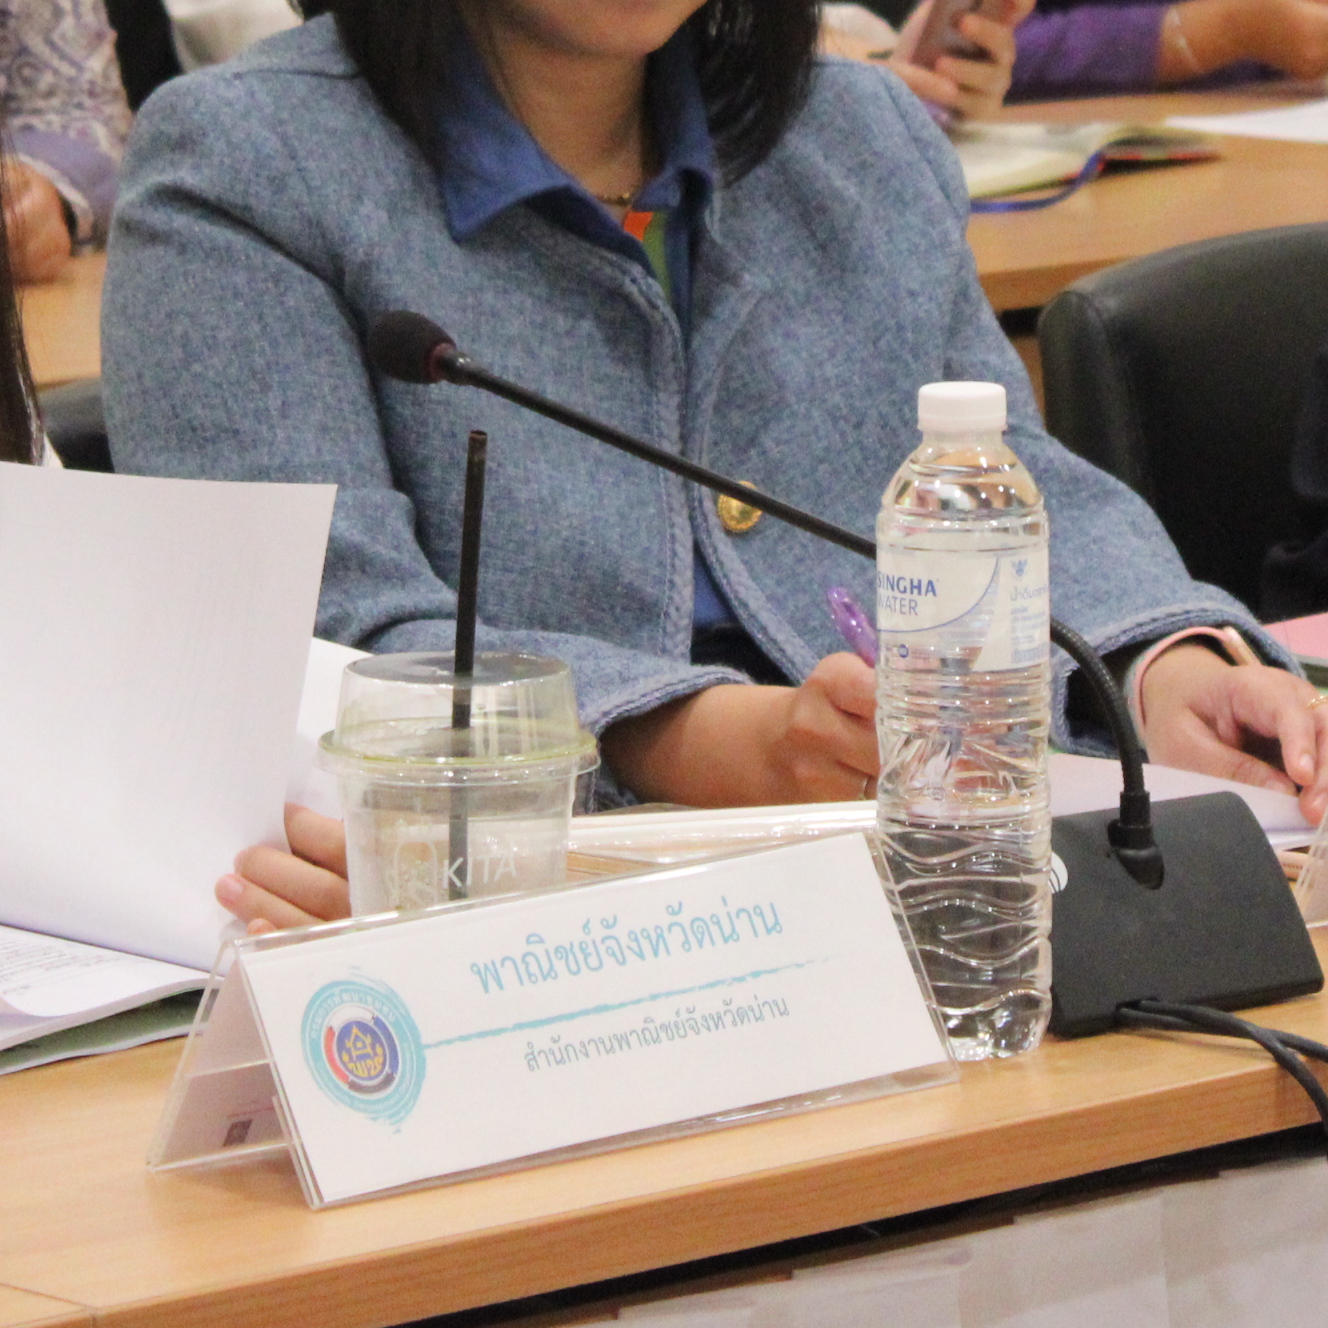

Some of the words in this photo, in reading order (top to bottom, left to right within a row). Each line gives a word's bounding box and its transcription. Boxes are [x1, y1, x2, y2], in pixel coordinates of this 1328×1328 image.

[442, 852, 517, 890] KITA
[470, 896, 783, 994] พาณิชย์จังหวัดน่าน
[524, 995, 790, 1071] สำนักงานพาณิชย์จังหวัดน่าน
